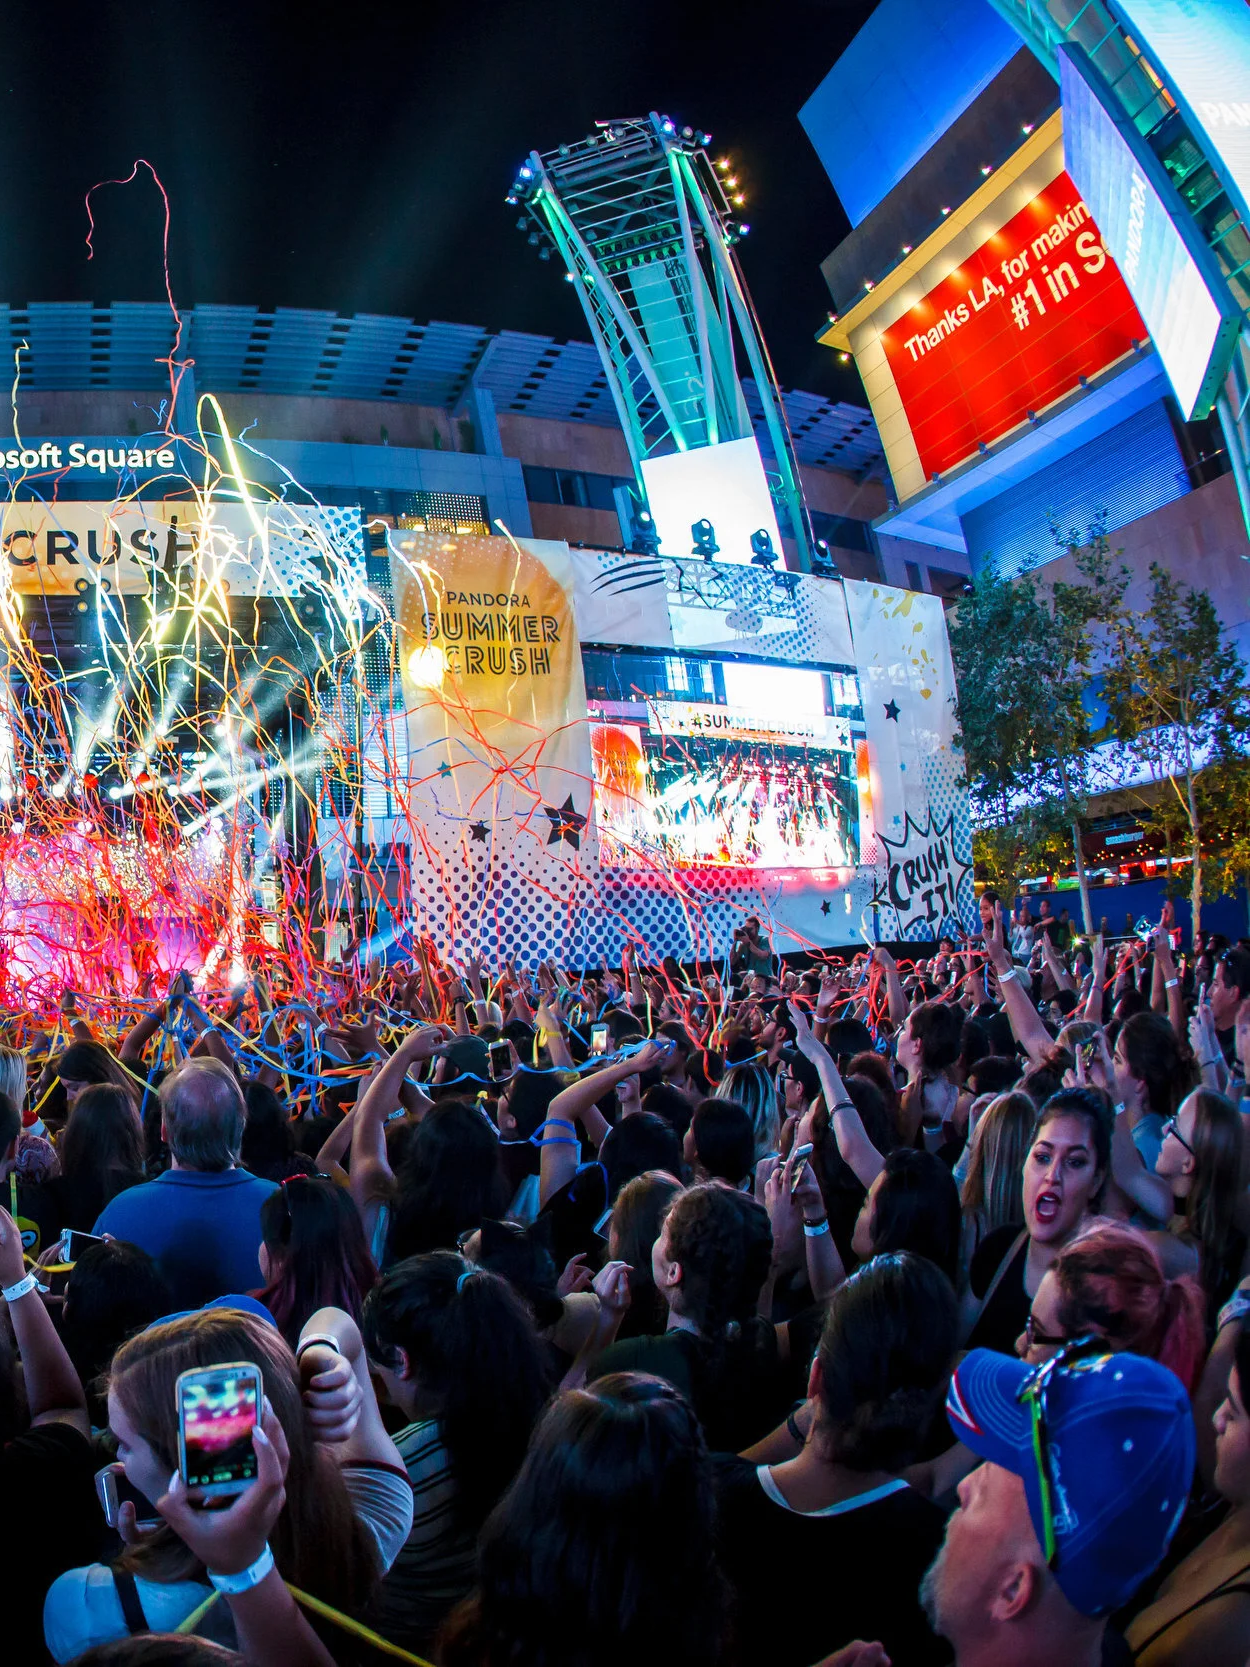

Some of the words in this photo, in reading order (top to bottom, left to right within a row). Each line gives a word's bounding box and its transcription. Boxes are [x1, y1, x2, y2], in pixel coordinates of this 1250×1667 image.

[904, 302, 971, 362] Thanks
[967, 276, 1005, 312] LA,
[1001, 249, 1029, 285] for
[1010, 278, 1047, 331] #1
[1041, 260, 1080, 304] in
[68, 442, 175, 474] Square
[446, 591, 531, 608] PANDORA
[421, 612, 561, 643] SUMMER
[445, 645, 551, 676] CRUSH
[889, 837, 949, 911] CRUSH
[921, 872, 957, 924] IT!
